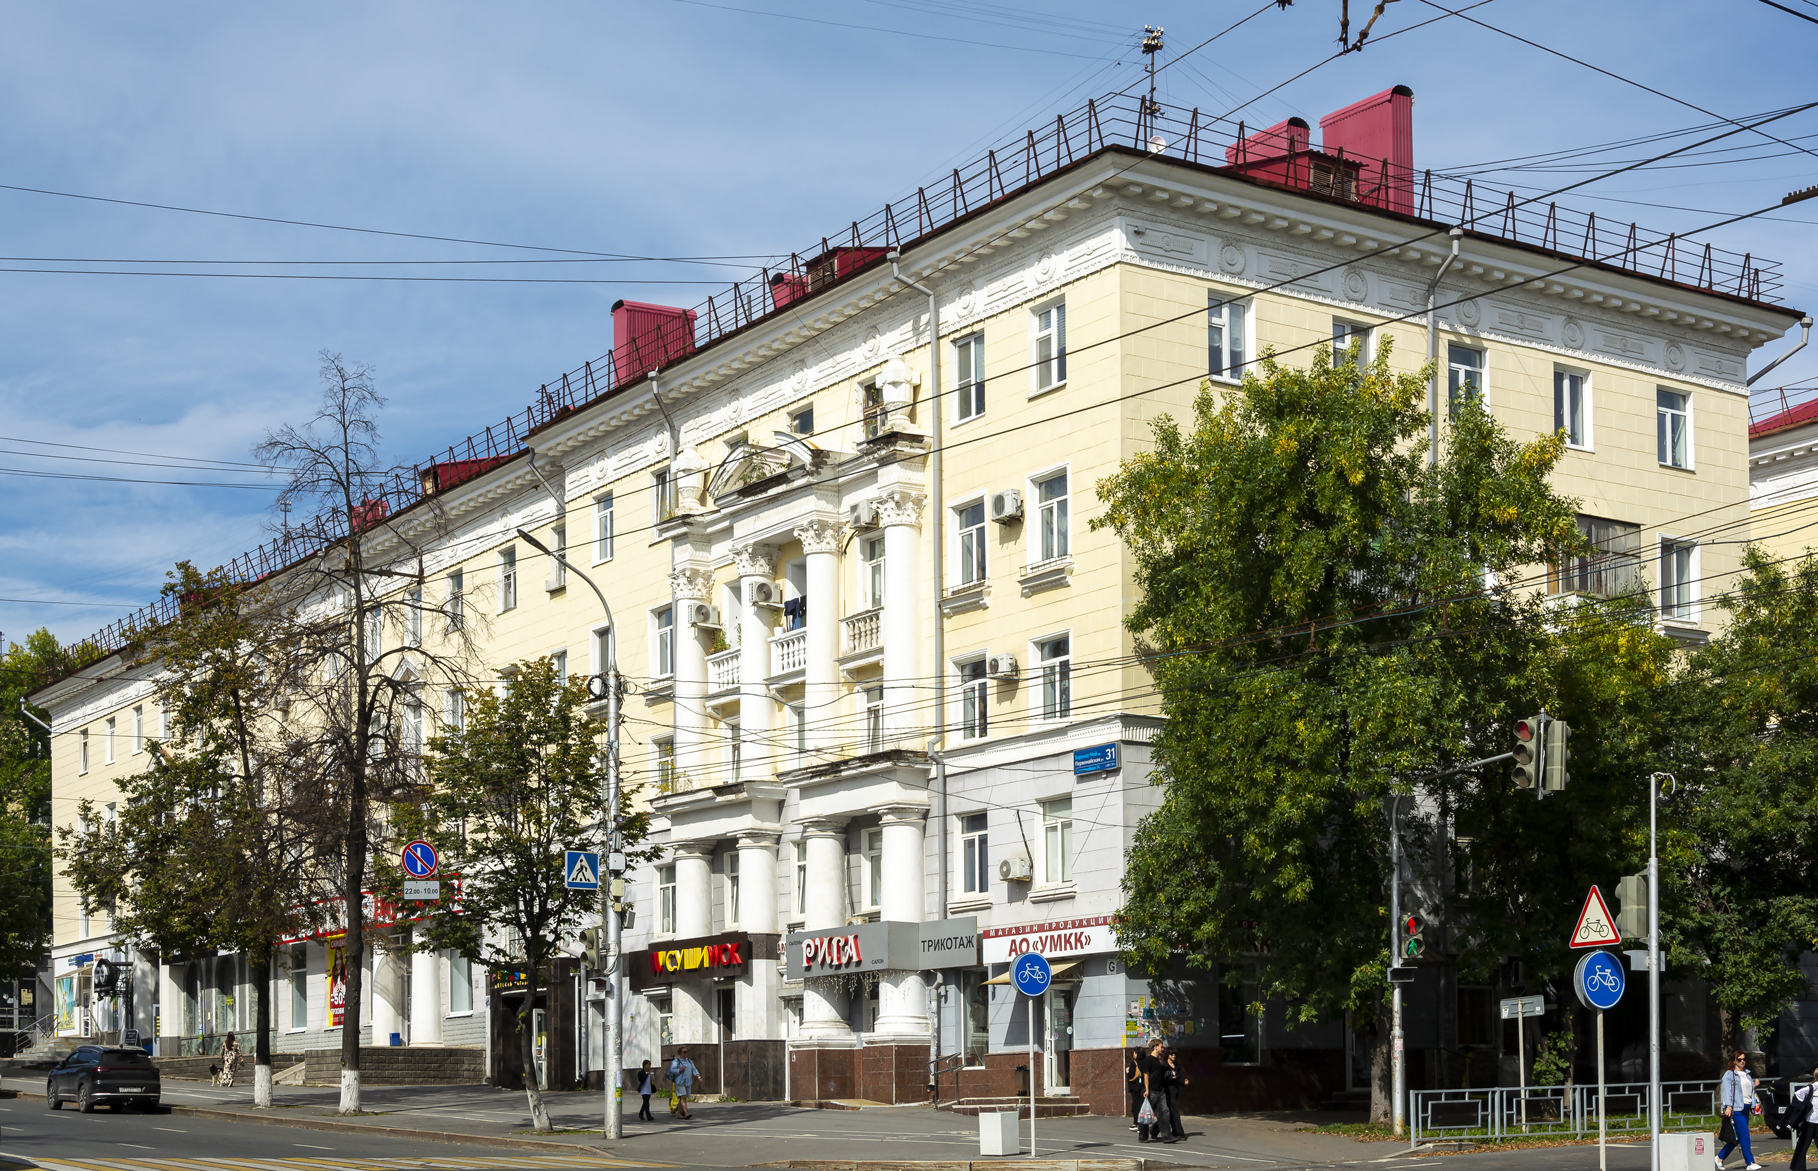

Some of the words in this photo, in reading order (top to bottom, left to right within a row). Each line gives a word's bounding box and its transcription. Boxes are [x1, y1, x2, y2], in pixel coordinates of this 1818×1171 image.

[1105, 747, 1115, 760] 31
[990, 925, 1038, 936] МАГАЗИН
[1044, 916, 1112, 930] ПРОДУКЦИИ
[802, 934, 862, 967] РИГА
[921, 935, 974, 952] ТРИКОТАЖ
[1008, 938, 1030, 957] АО
[1032, 931, 1092, 953] «УМКК»
[1108, 961, 1115, 973] G
[331, 993, 345, 1005] -50
